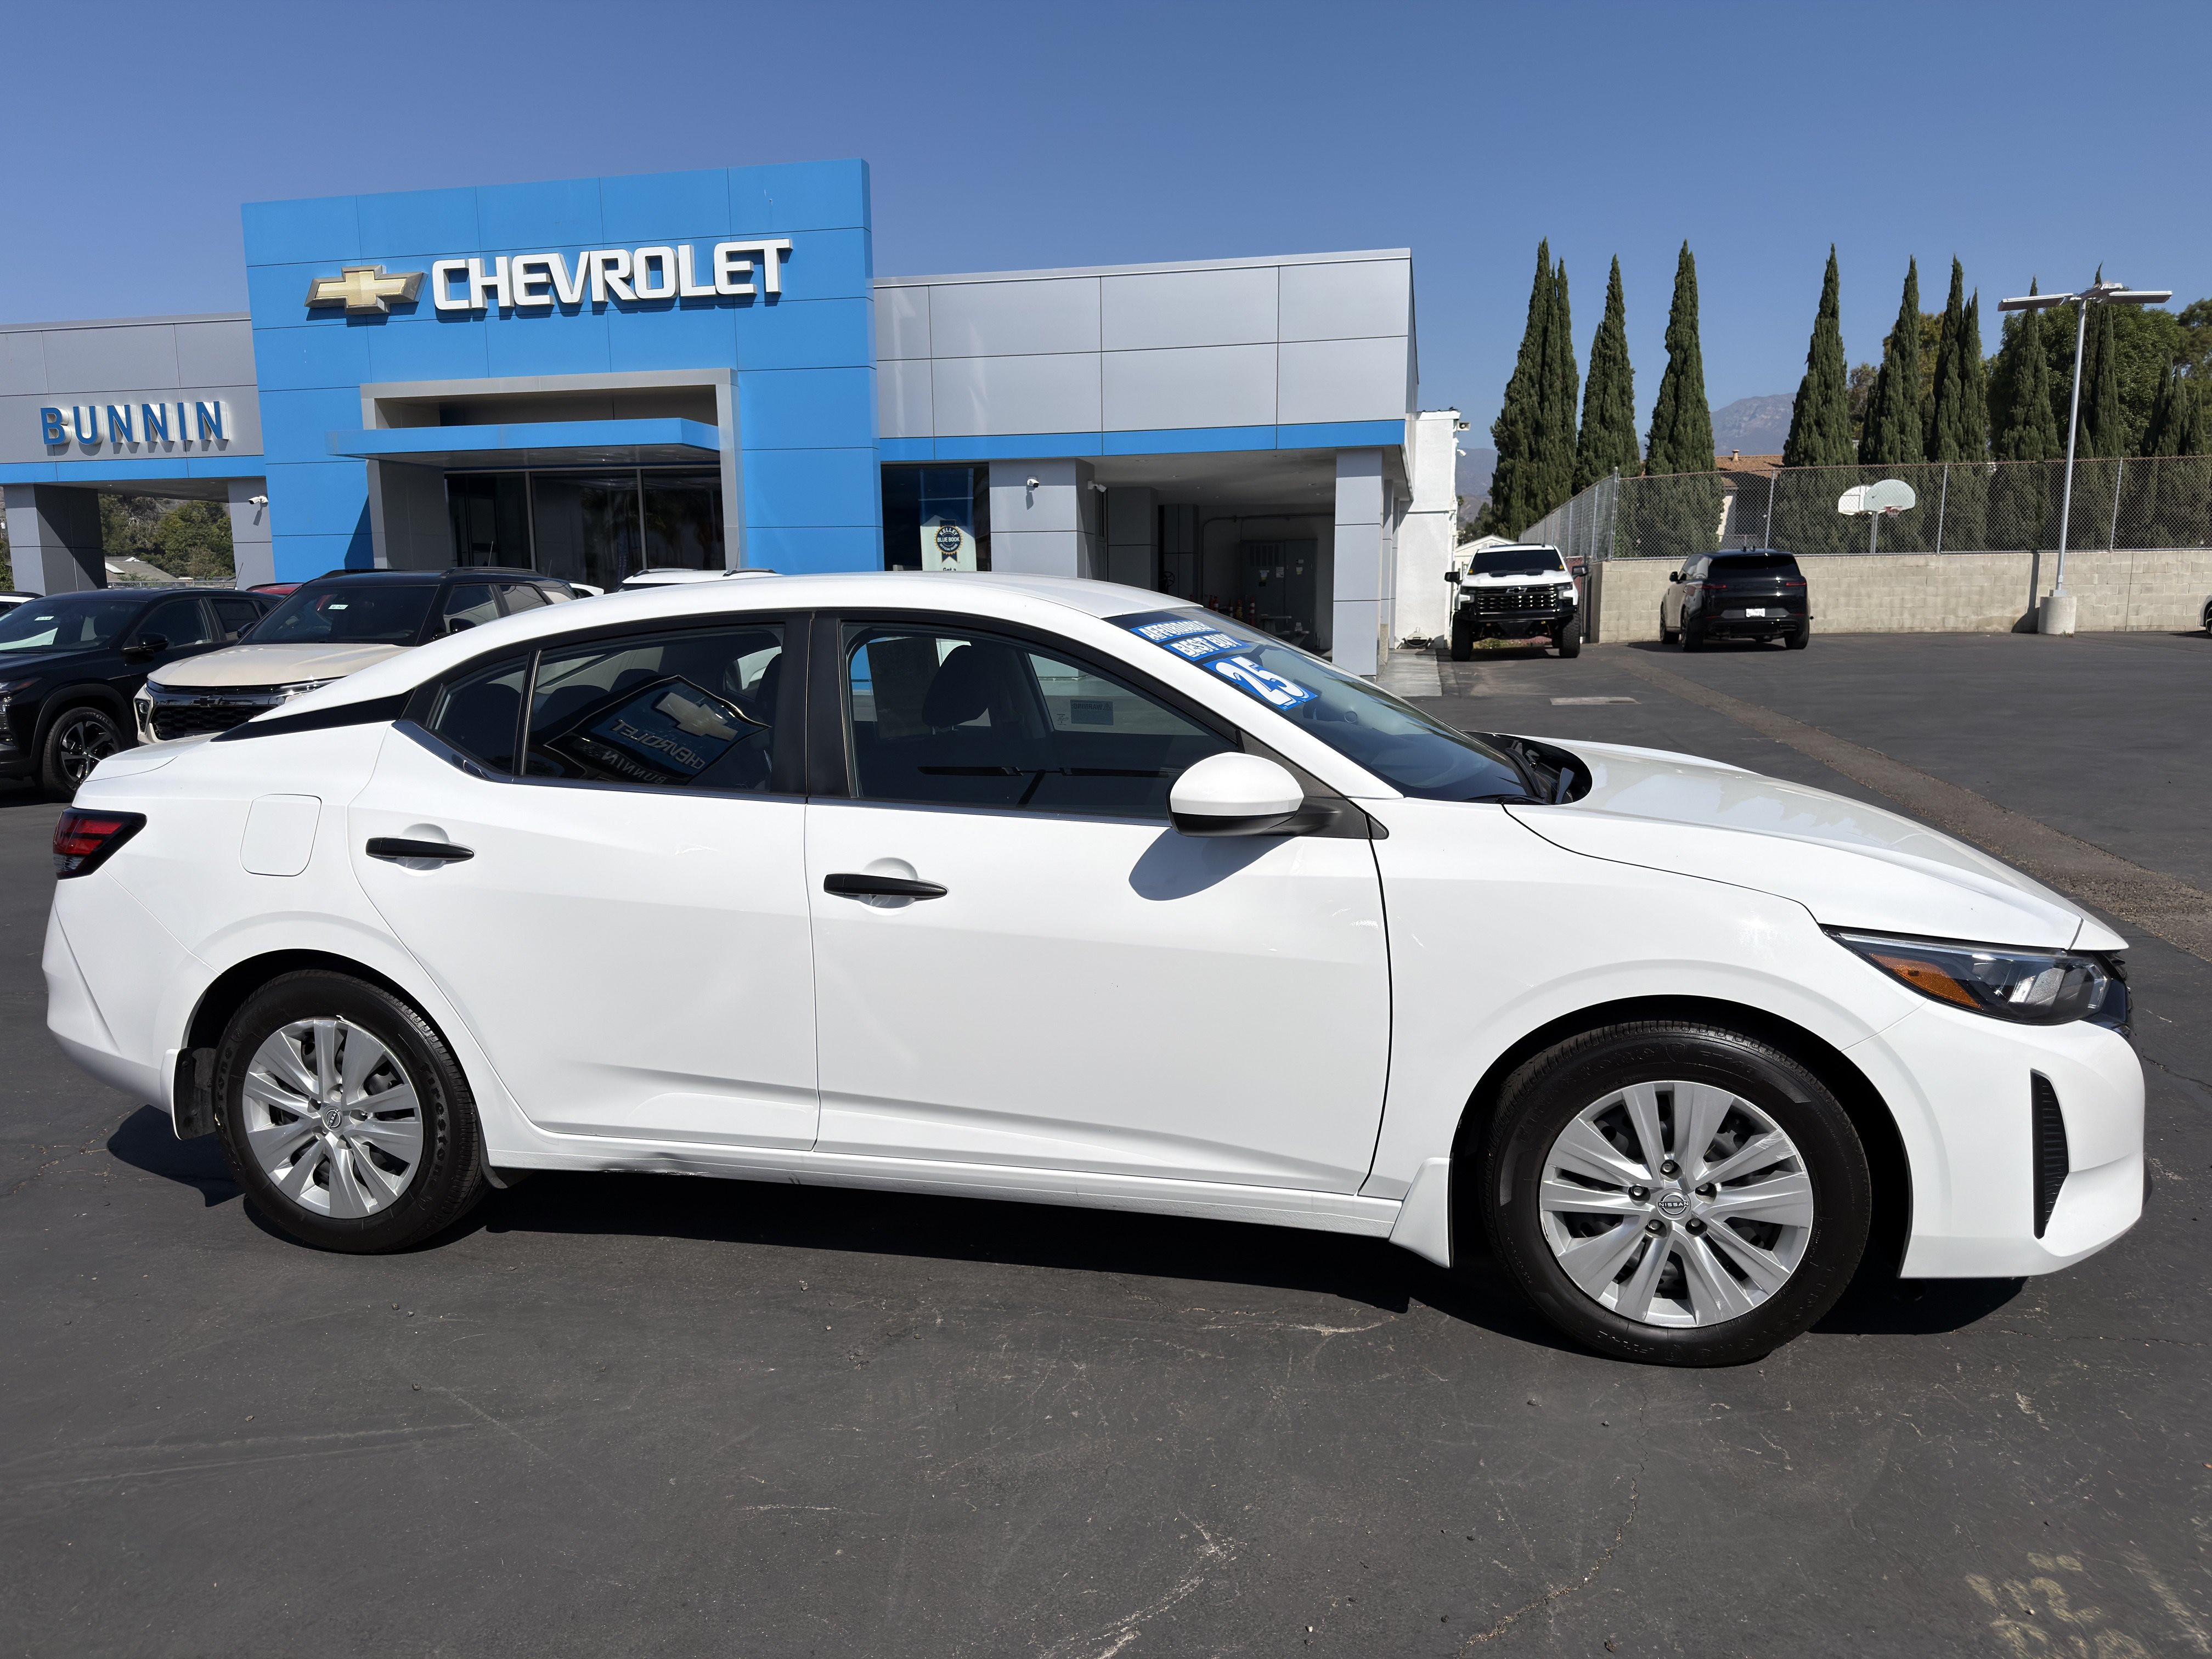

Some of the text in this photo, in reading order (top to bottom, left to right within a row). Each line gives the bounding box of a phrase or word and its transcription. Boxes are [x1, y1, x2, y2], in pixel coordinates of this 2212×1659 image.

[432, 238, 793, 311] CHEVROLET
[40, 401, 229, 445] BUNNIN
[1138, 620, 1217, 641] AFFORDABLE
[1170, 634, 1242, 657] BEST BUY
[1215, 656, 1310, 706] 25
[328, 1109, 340, 1128] NISSAN
